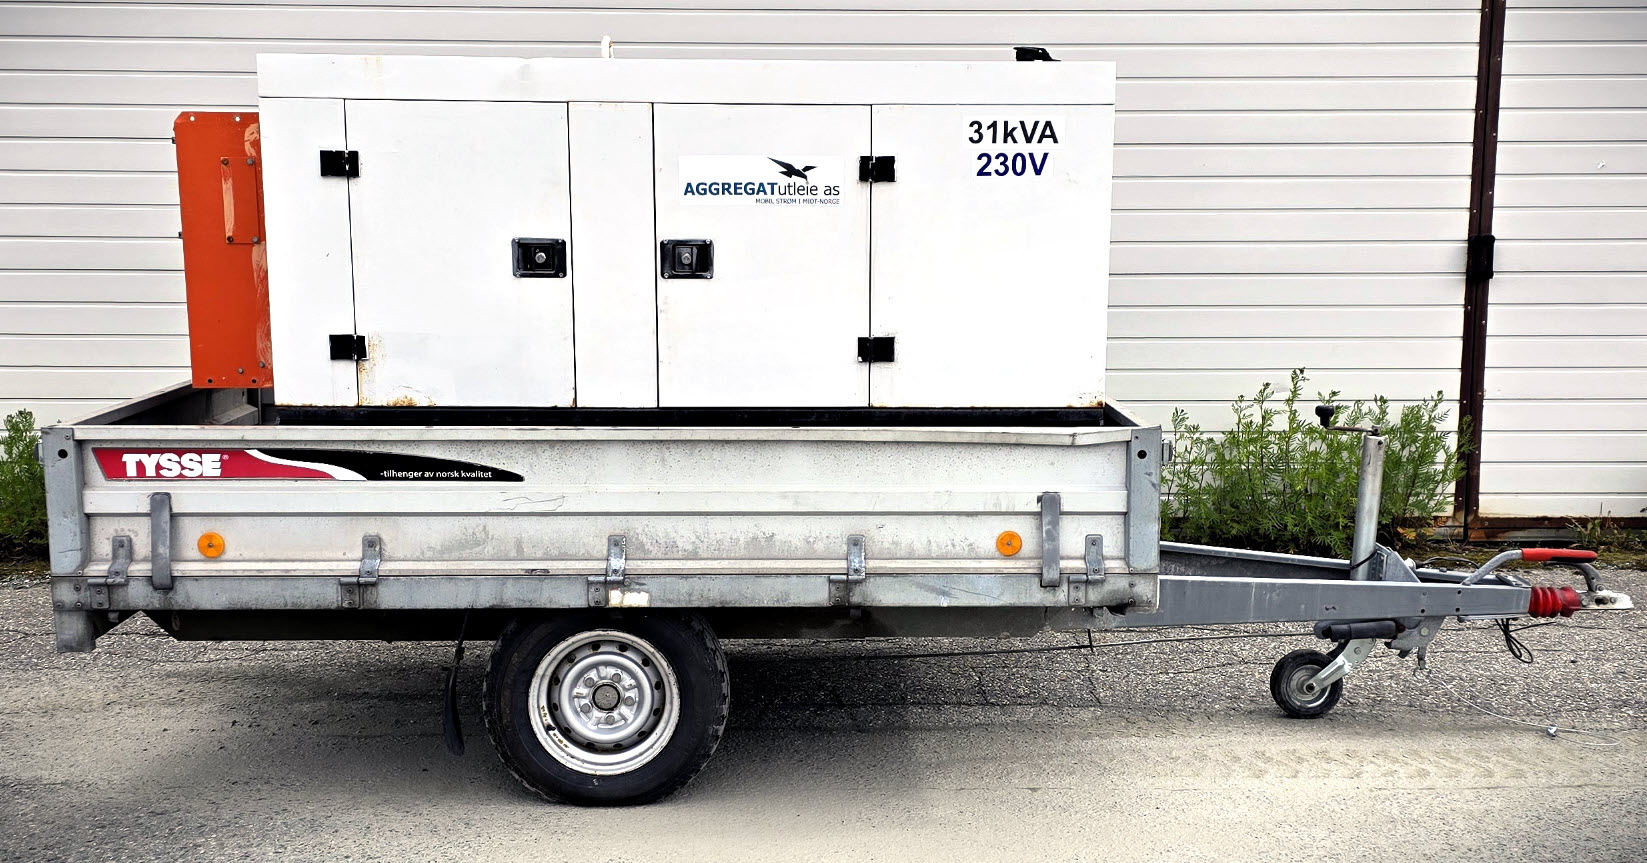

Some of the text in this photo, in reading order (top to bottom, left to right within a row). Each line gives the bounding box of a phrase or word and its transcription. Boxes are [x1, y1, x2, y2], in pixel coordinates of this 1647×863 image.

[968, 120, 1059, 144] 31kVA
[976, 152, 1050, 177] 230V
[823, 185, 840, 196] as
[436, 470, 459, 478] norsk
[461, 470, 492, 478] kvalitet
